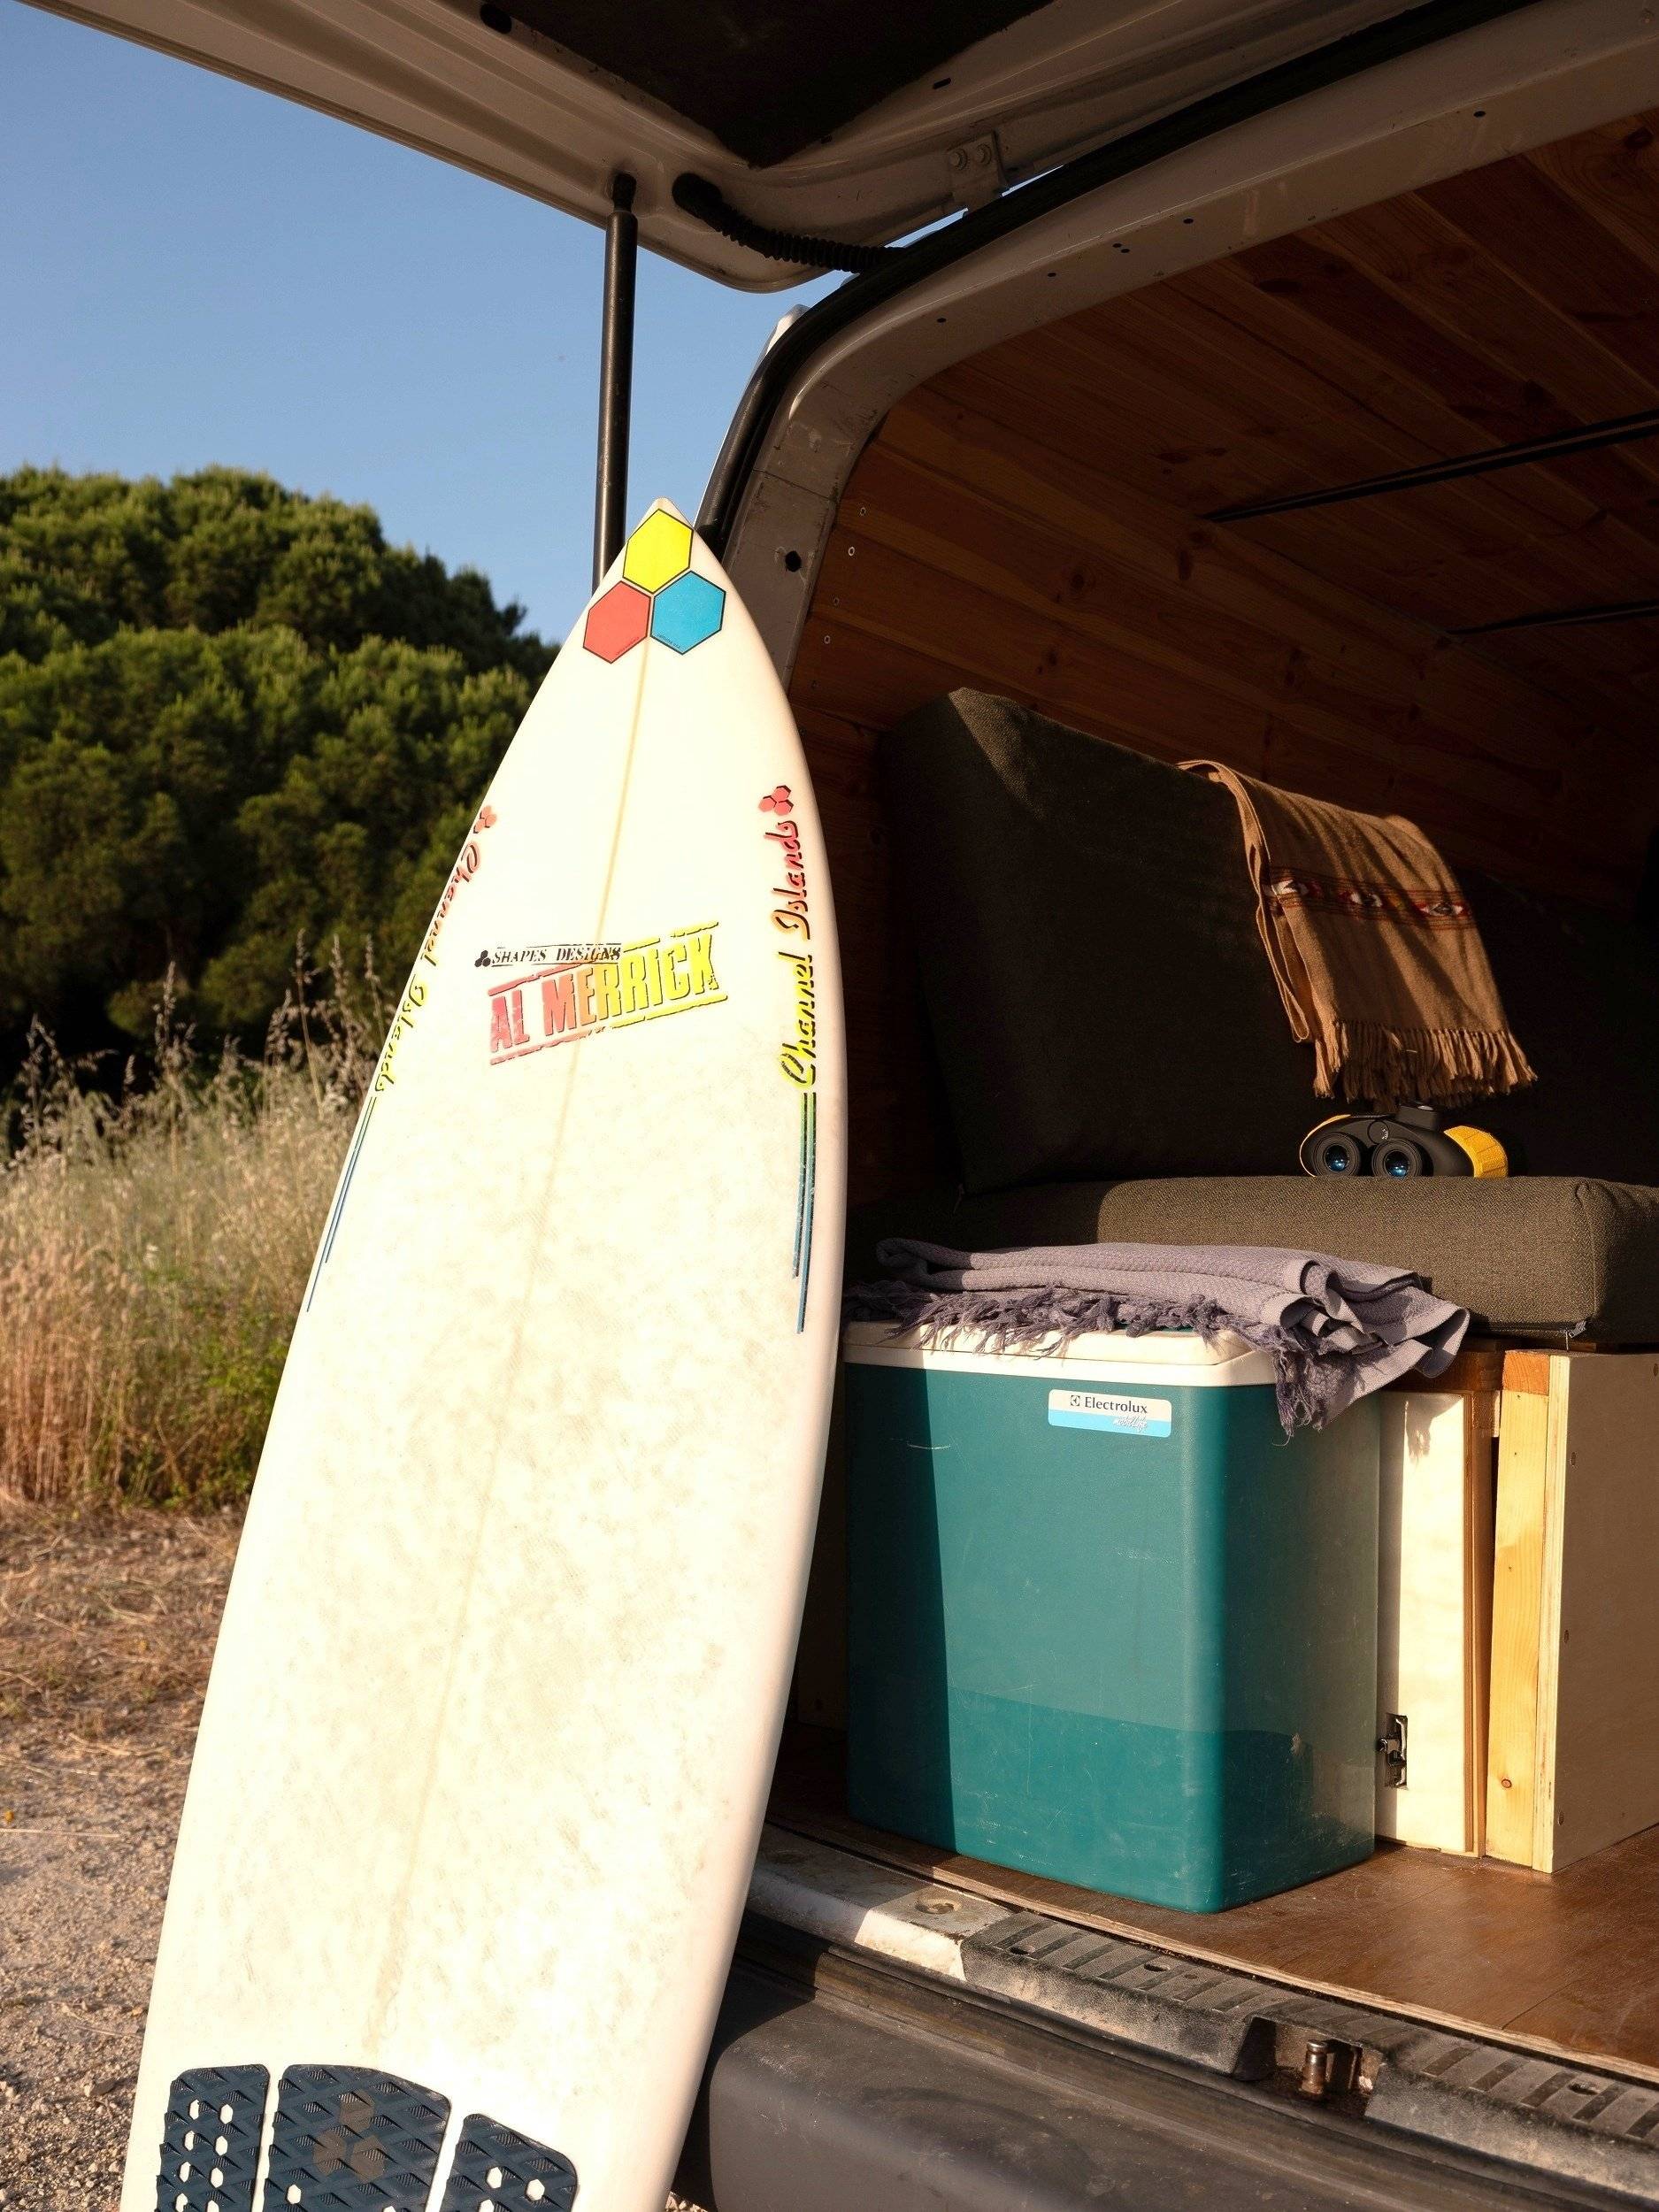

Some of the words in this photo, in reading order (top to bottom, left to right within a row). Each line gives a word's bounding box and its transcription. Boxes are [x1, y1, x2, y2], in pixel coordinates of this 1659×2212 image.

[419, 841, 480, 966] Channel
[764, 819, 811, 941] Islands
[490, 948, 547, 963] SHAPES
[556, 945, 621, 962] DESIGNS
[490, 989, 530, 1053] AL
[541, 933, 719, 1036] MERRICK
[776, 951, 817, 1086] Channel
[1084, 1396, 1148, 1414] Electrolux
